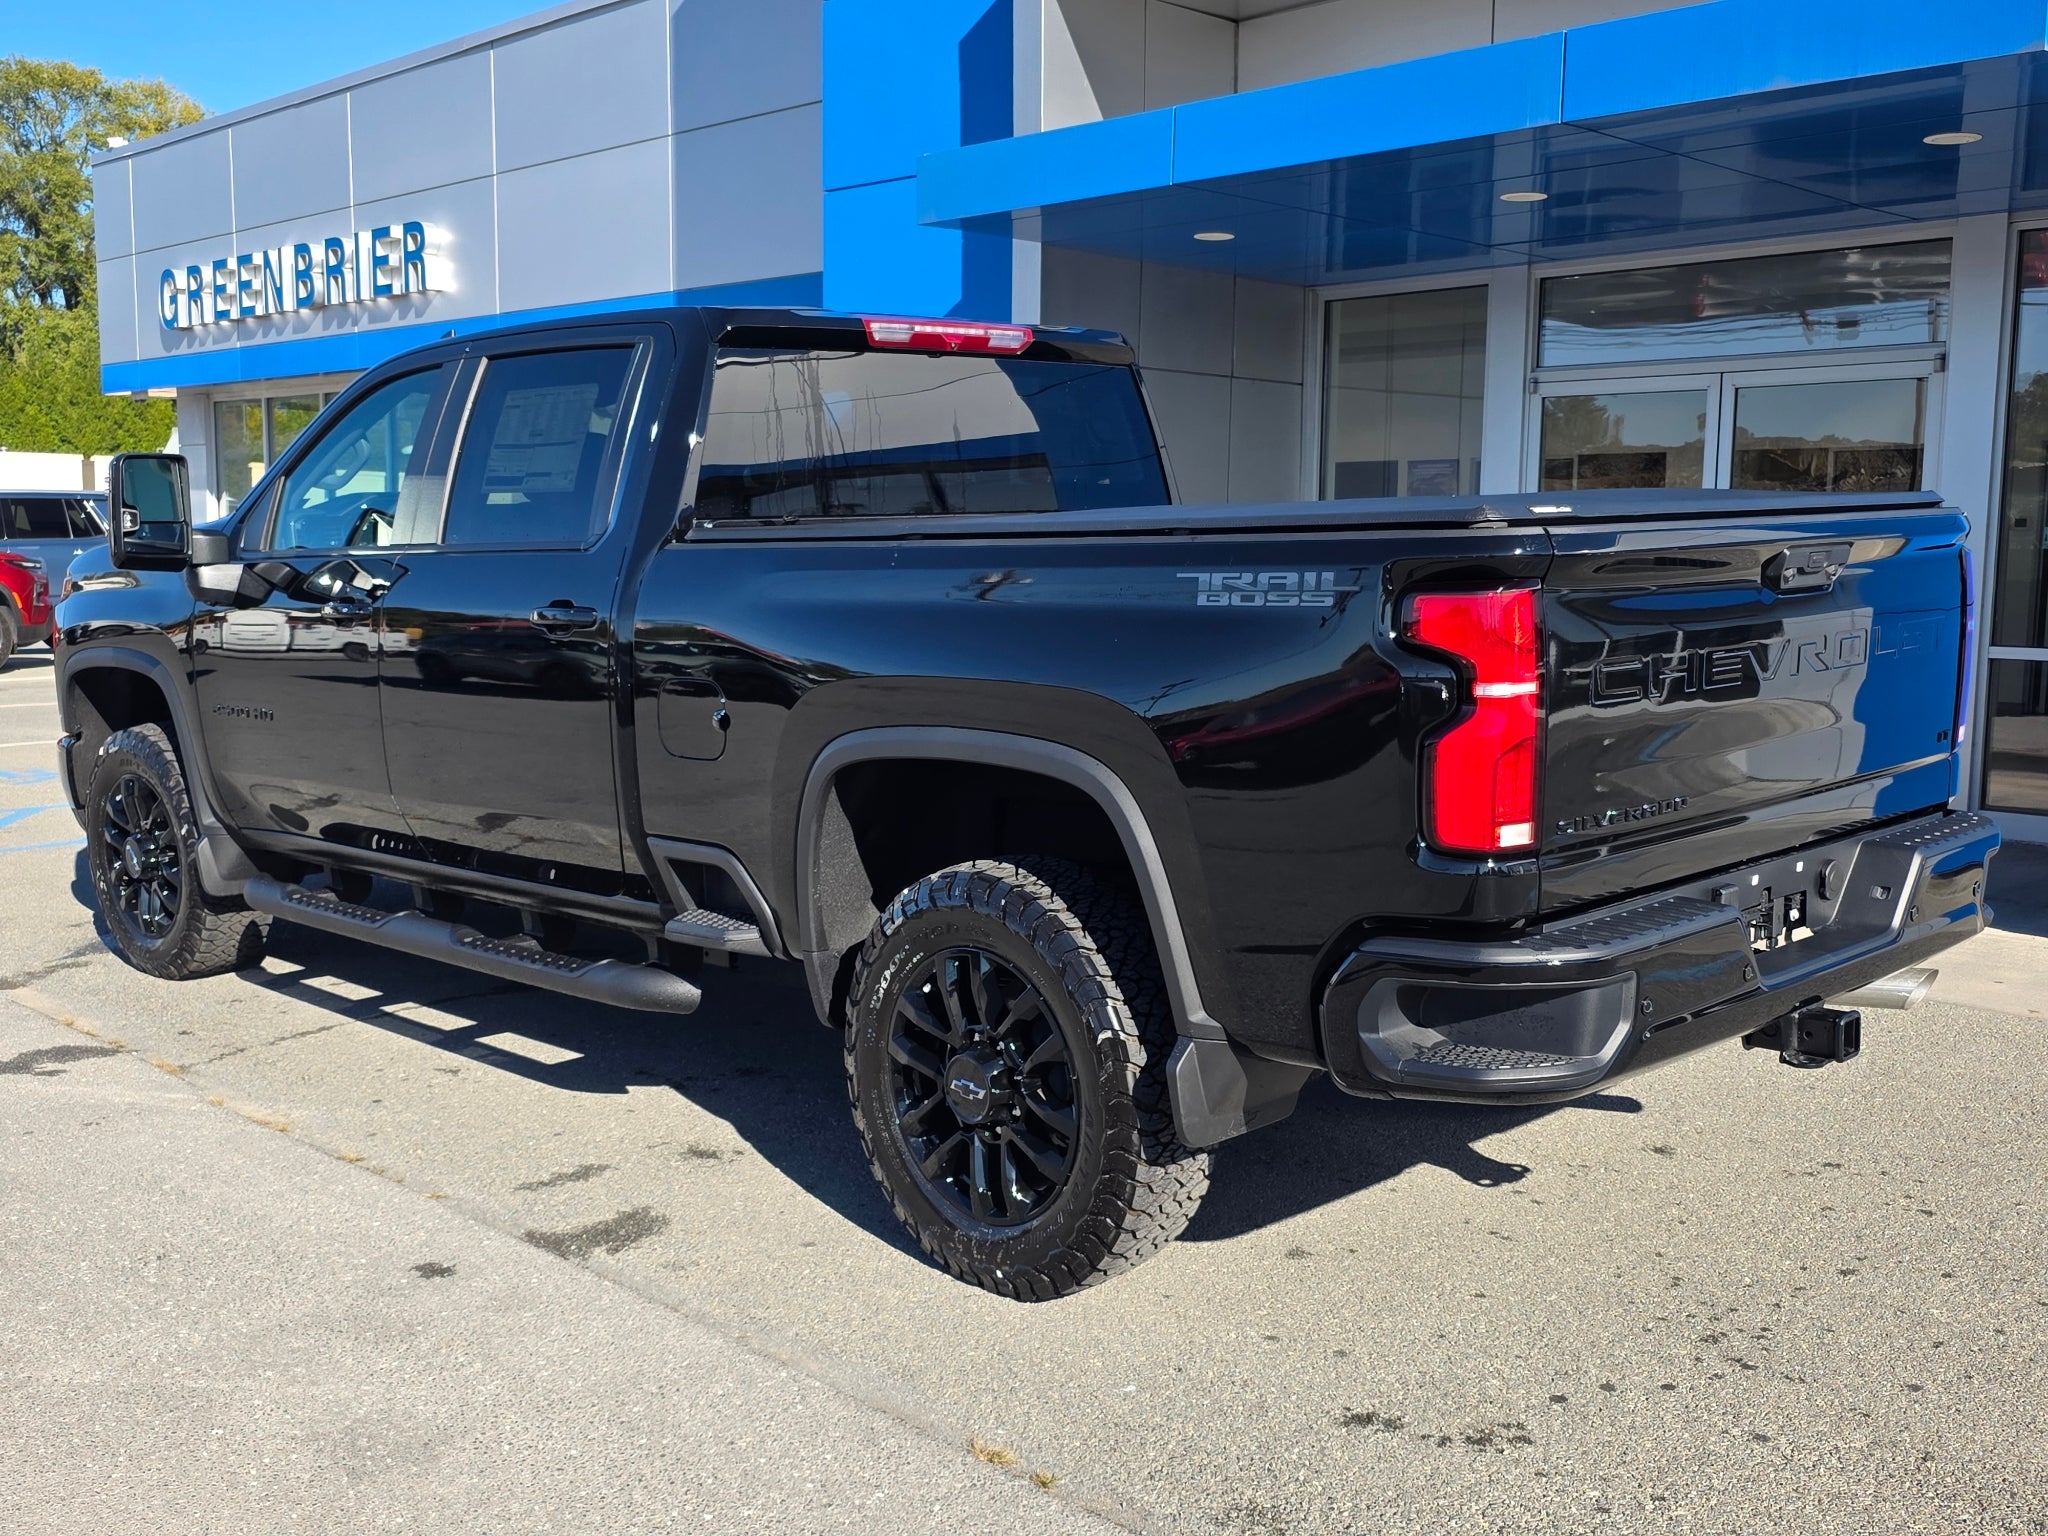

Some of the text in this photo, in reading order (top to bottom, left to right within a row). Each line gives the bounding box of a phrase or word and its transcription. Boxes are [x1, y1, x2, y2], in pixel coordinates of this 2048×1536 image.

[159, 221, 428, 331] GREENBRIER
[1176, 571, 1360, 591] TRAIL
[1196, 591, 1335, 606] BOSS
[1590, 615, 1947, 707] CHEVROLET
[1556, 797, 1689, 836] SILVERADO
